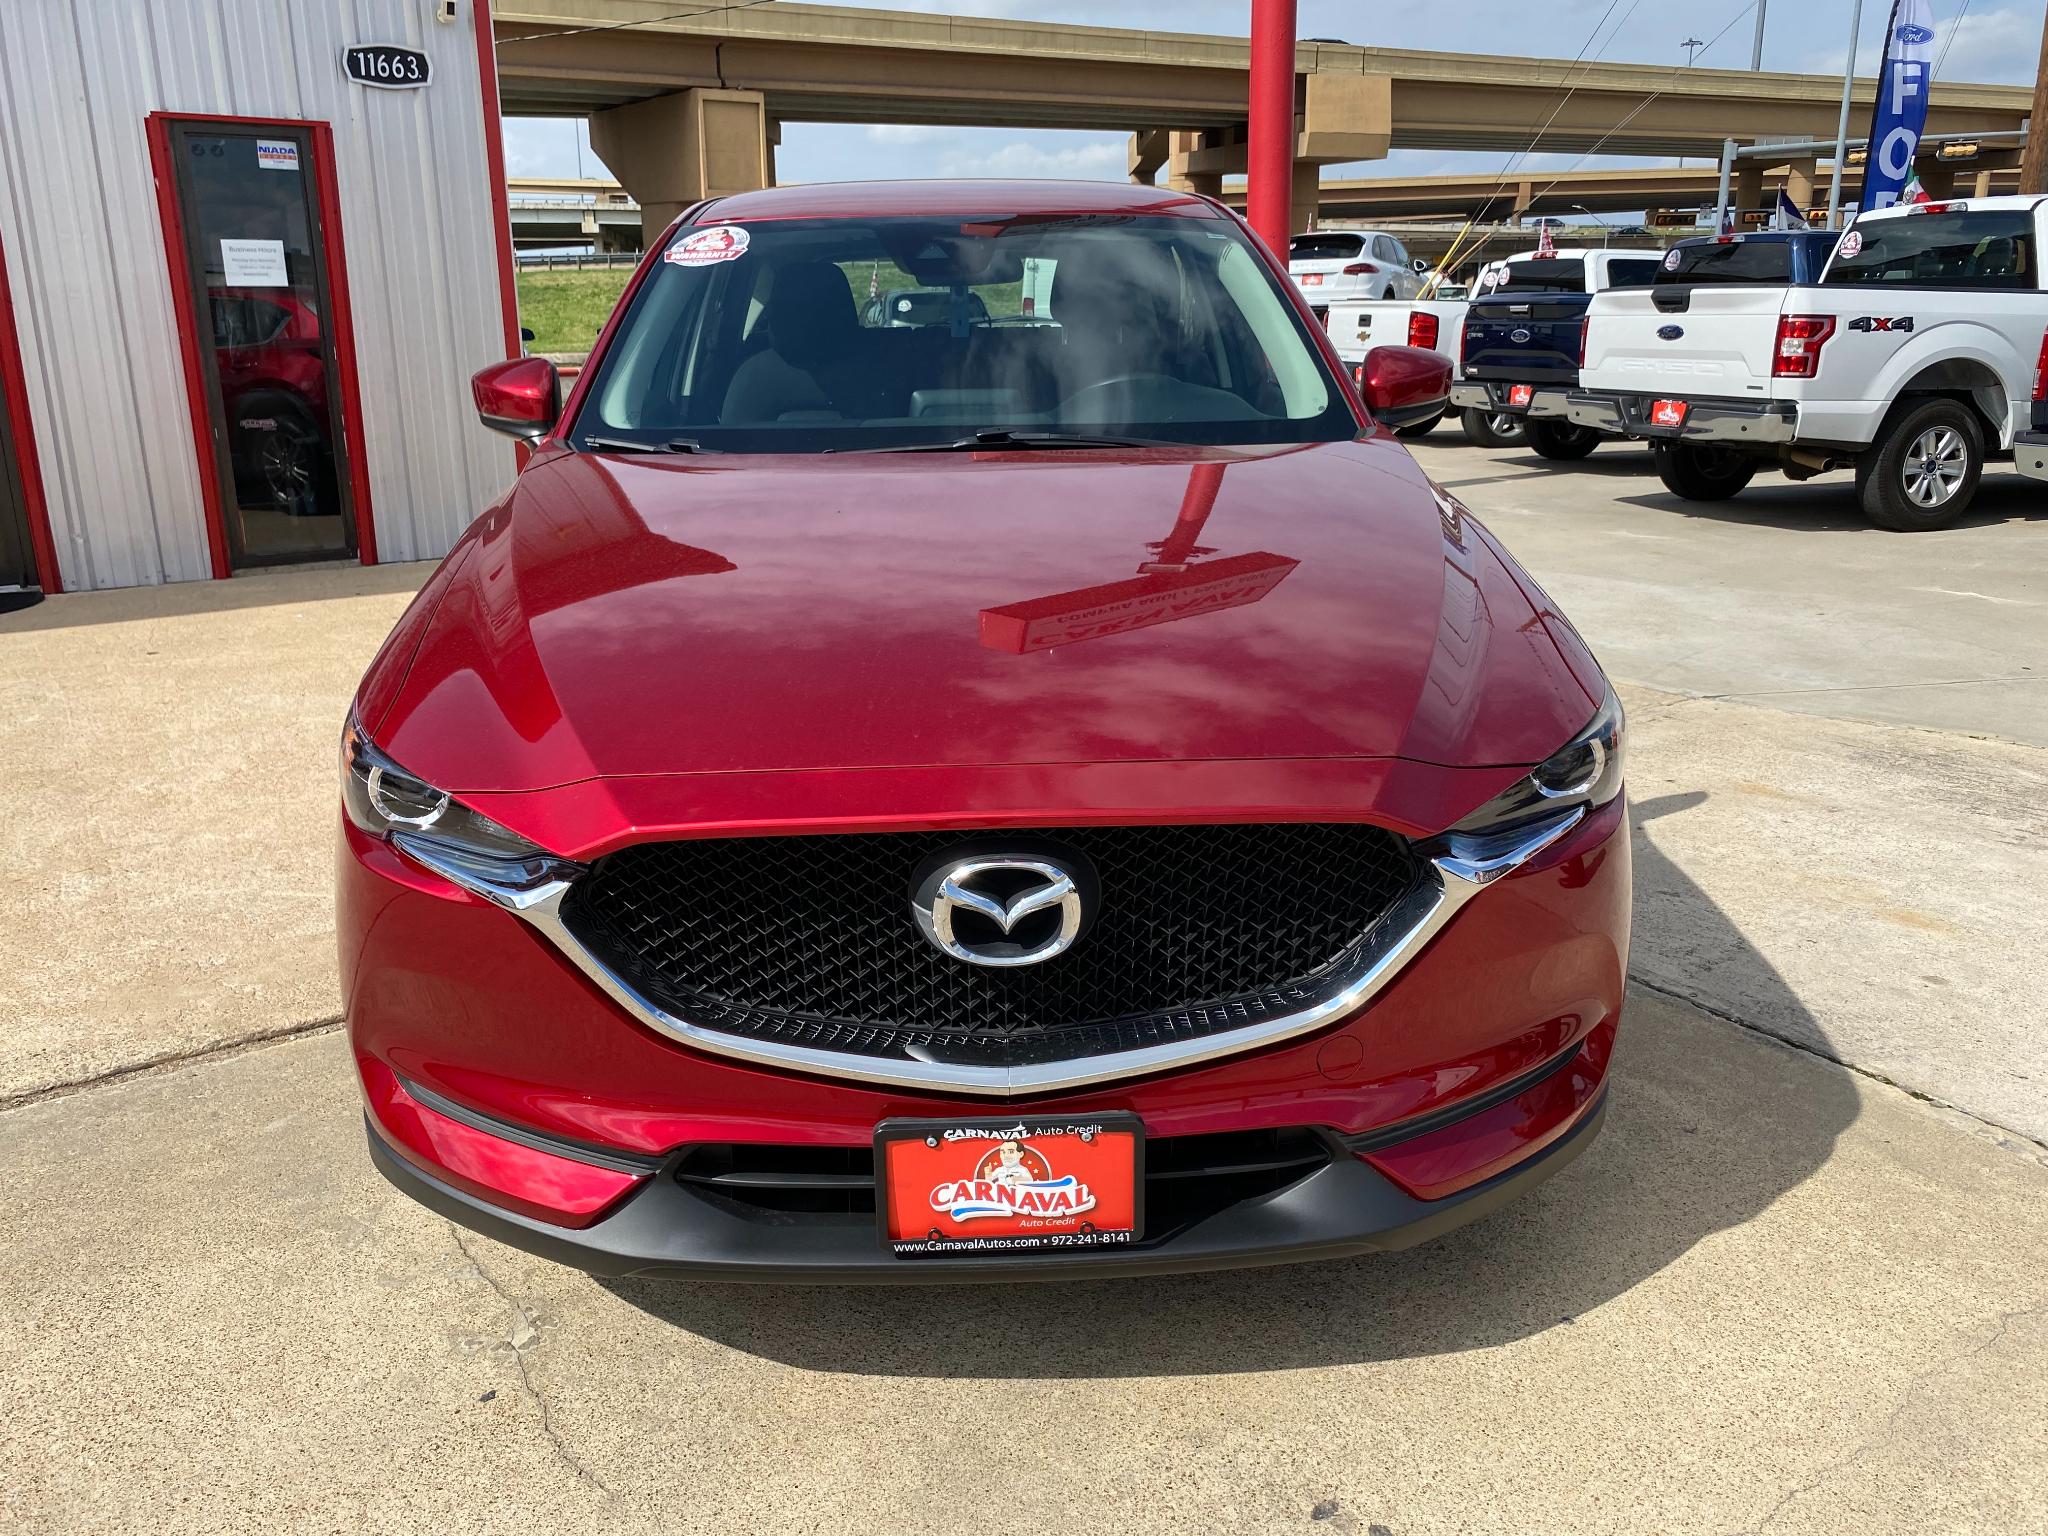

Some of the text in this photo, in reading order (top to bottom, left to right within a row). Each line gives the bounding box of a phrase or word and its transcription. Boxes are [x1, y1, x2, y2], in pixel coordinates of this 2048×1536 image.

[357, 52, 420, 80] 11663
[258, 146, 295, 155] NIADA
[670, 251, 736, 260] WARRANTY
[943, 1124, 1103, 1141] CARNAVAL Auto Credit
[930, 1180, 1094, 1214] CARNAVAL
[1019, 1216, 1076, 1228] Auto Credit
[893, 1232, 1131, 1252] www.CarnavalAutos.com 972-241-8141
